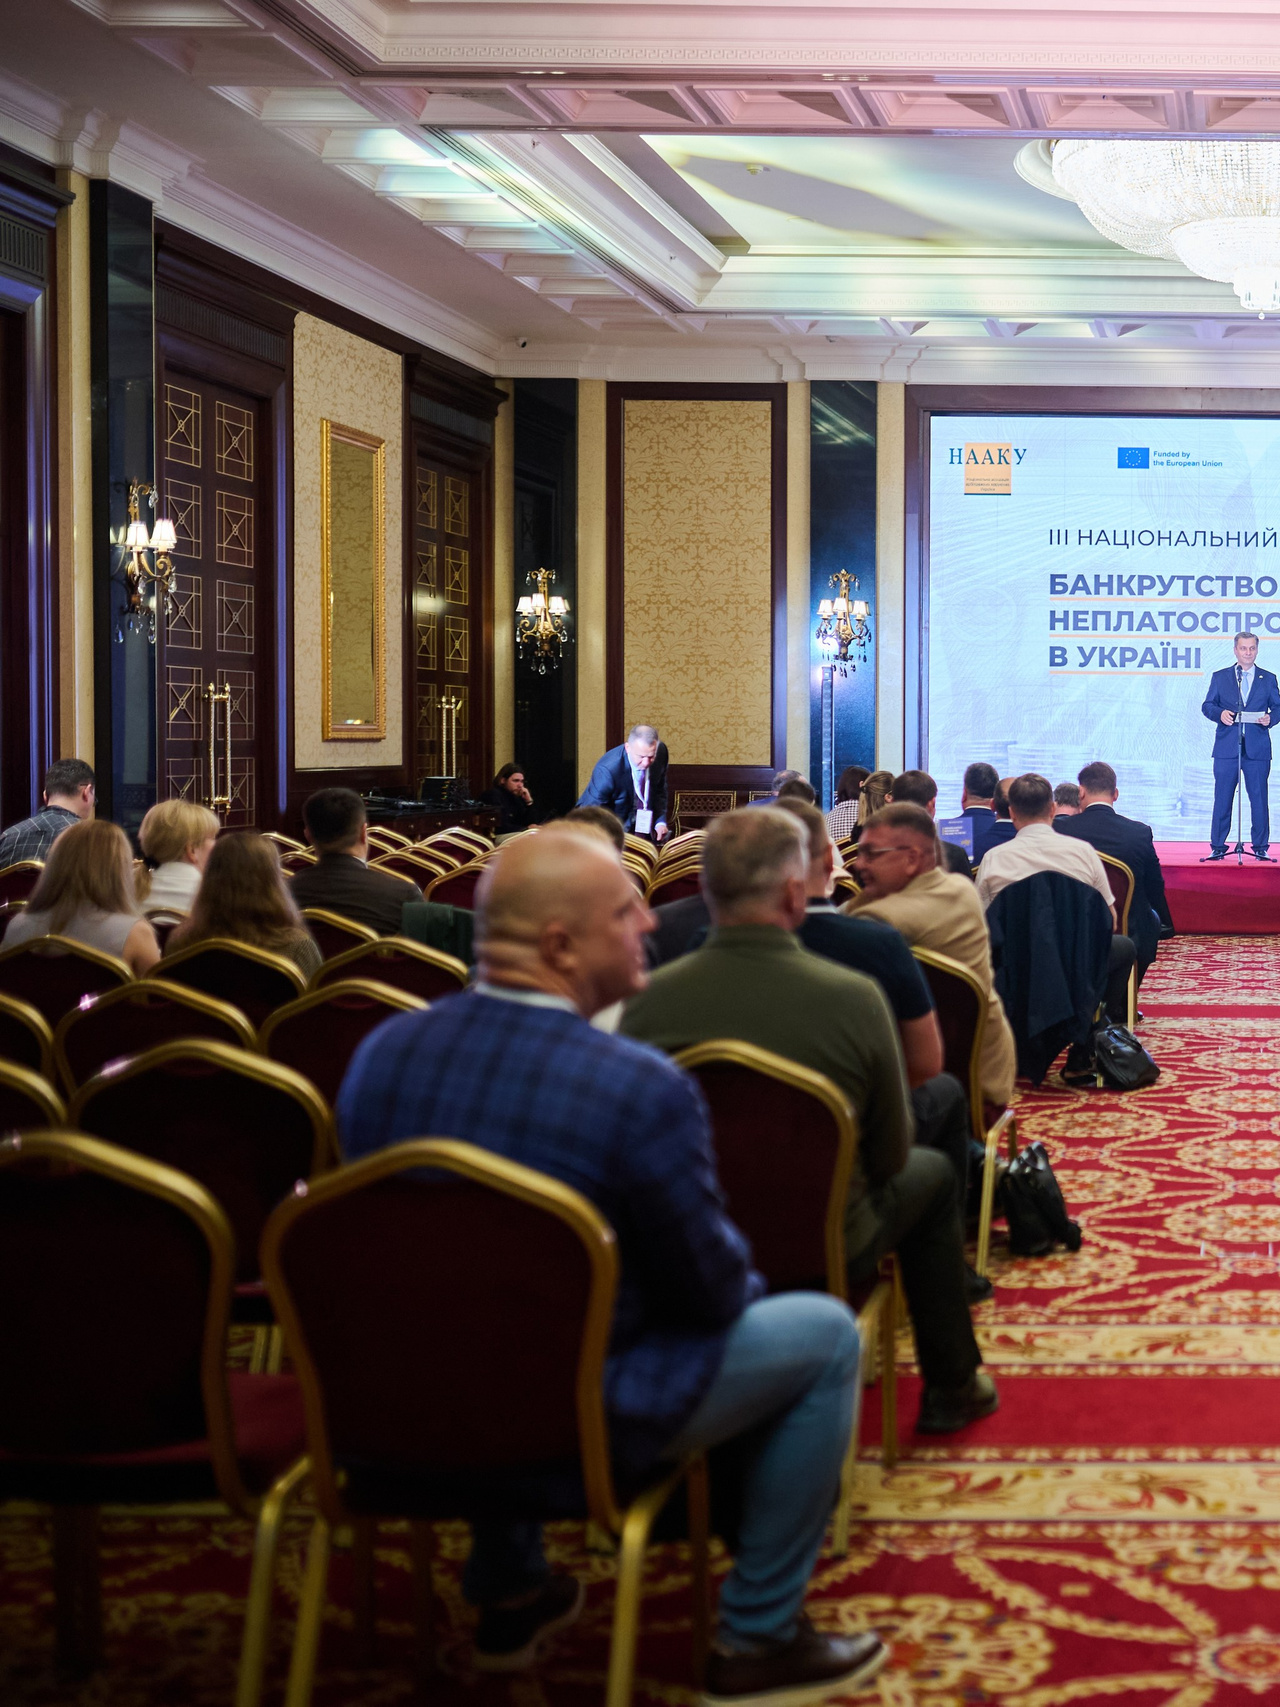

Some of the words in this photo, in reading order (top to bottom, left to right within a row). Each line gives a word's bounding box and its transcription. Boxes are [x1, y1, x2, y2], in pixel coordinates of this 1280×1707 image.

[949, 447, 1027, 465] НААКУ
[1153, 450, 1180, 458] Funded
[1181, 451, 1191, 459] by
[1166, 459, 1200, 467] European
[1078, 527, 1277, 549] НАЦІОНАЛЬНИЙ
[1050, 574, 1278, 598] БАНКРУТСТВО
[1049, 645, 1068, 667] В
[1076, 641, 1201, 669] УКРАЇНІ
